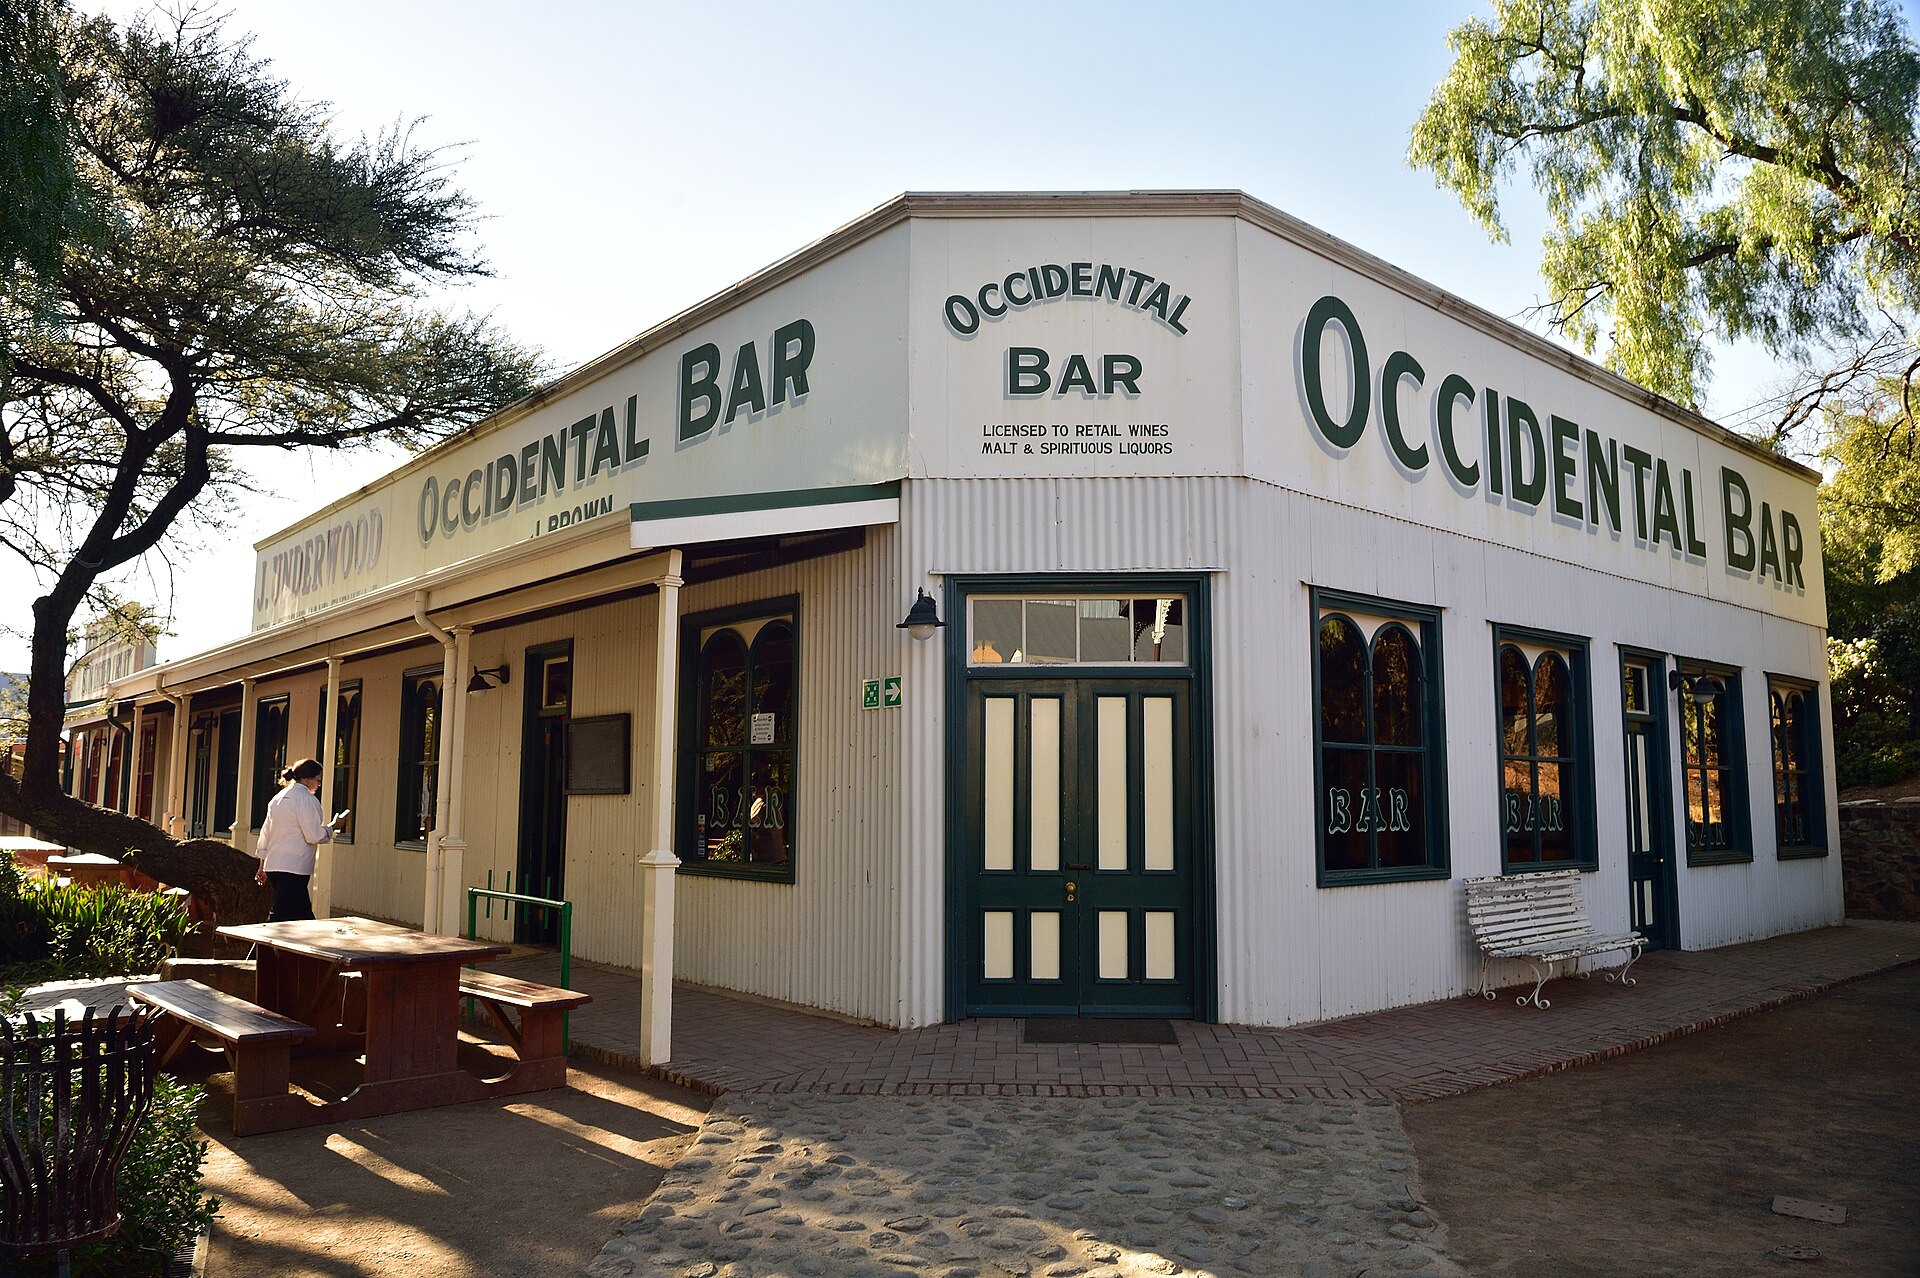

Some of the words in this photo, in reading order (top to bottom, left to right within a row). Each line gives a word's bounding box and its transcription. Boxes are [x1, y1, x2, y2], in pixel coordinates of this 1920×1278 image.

[944, 262, 1192, 336] OCCIDENTAL
[1006, 346, 1143, 398] BAR
[420, 393, 650, 543] OCCIDENTAL
[679, 318, 816, 440] BAR
[981, 442, 1018, 455] MALT
[1023, 442, 1034, 455] &
[1040, 442, 1113, 455] SPIRITUOUS
[1119, 442, 1173, 455] LIQUORS
[983, 424, 1047, 437] LICENSED
[1052, 424, 1069, 437] TO
[1075, 424, 1122, 437] RETAIL
[1128, 424, 1169, 437] WINES
[1300, 295, 1707, 560] OCCIDENTAL
[1721, 465, 1806, 591] BAR
[256, 560, 269, 612] J.
[272, 507, 383, 606] UNDERWOOD
[710, 785, 785, 829] BAR
[1328, 787, 1411, 835] BAR
[1505, 792, 1564, 833] BAR
